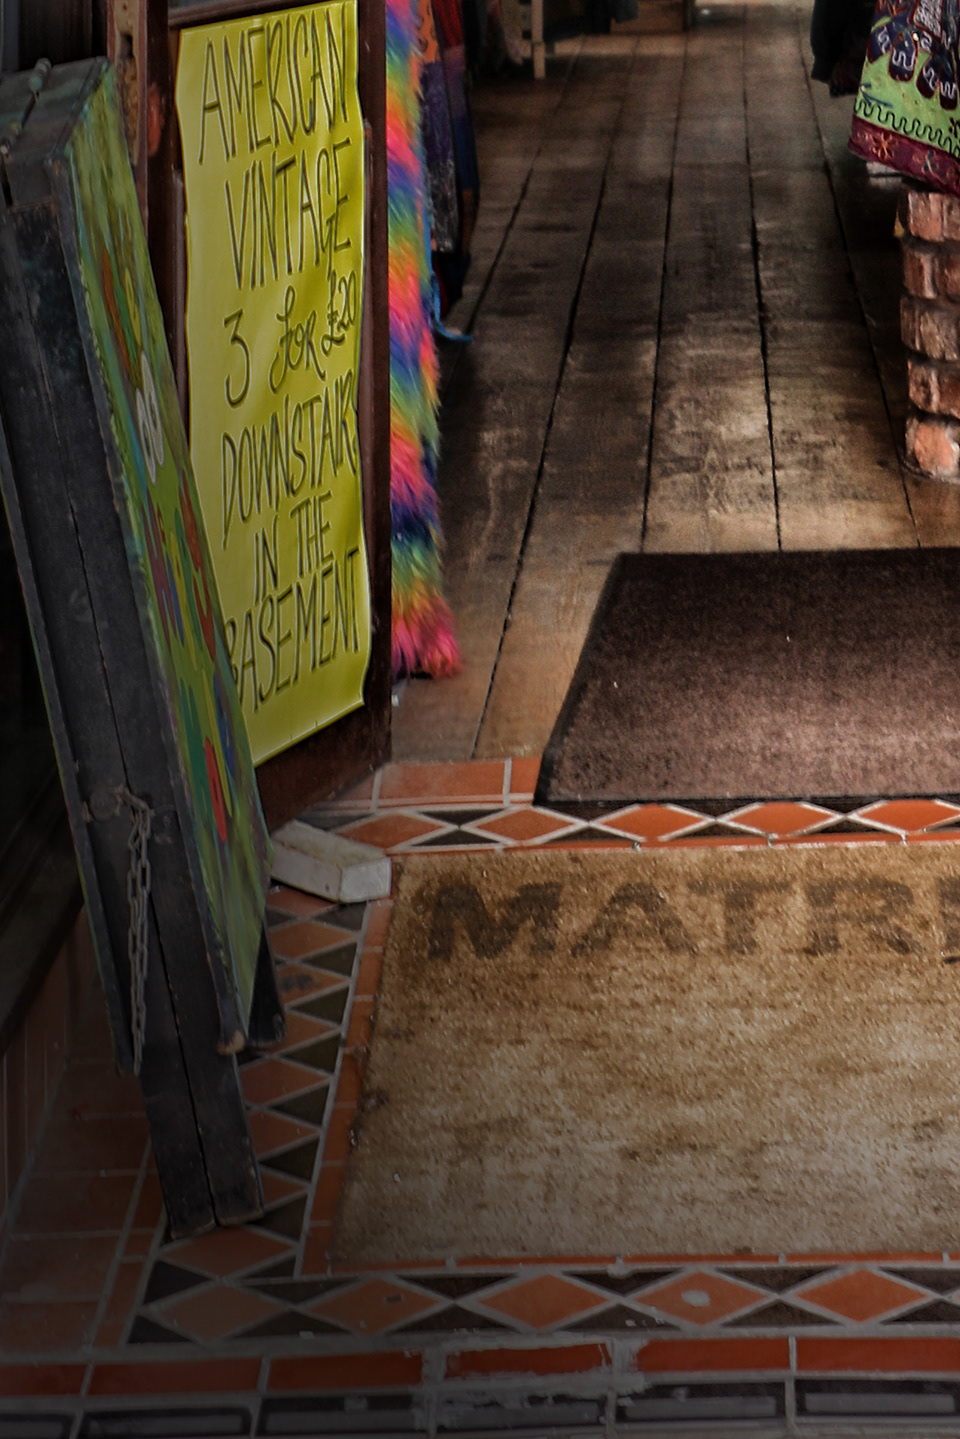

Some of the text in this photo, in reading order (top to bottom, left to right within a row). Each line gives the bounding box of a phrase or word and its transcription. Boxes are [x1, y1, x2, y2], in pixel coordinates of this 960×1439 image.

[199, 10, 350, 165] AMERICAN
[223, 136, 352, 291] VINTAGE
[223, 307, 251, 409] 3
[320, 268, 358, 358] £20
[221, 368, 358, 551] DOWNSTAIR
[253, 489, 335, 607] IN THE
[225, 545, 360, 712] BASEMENT
